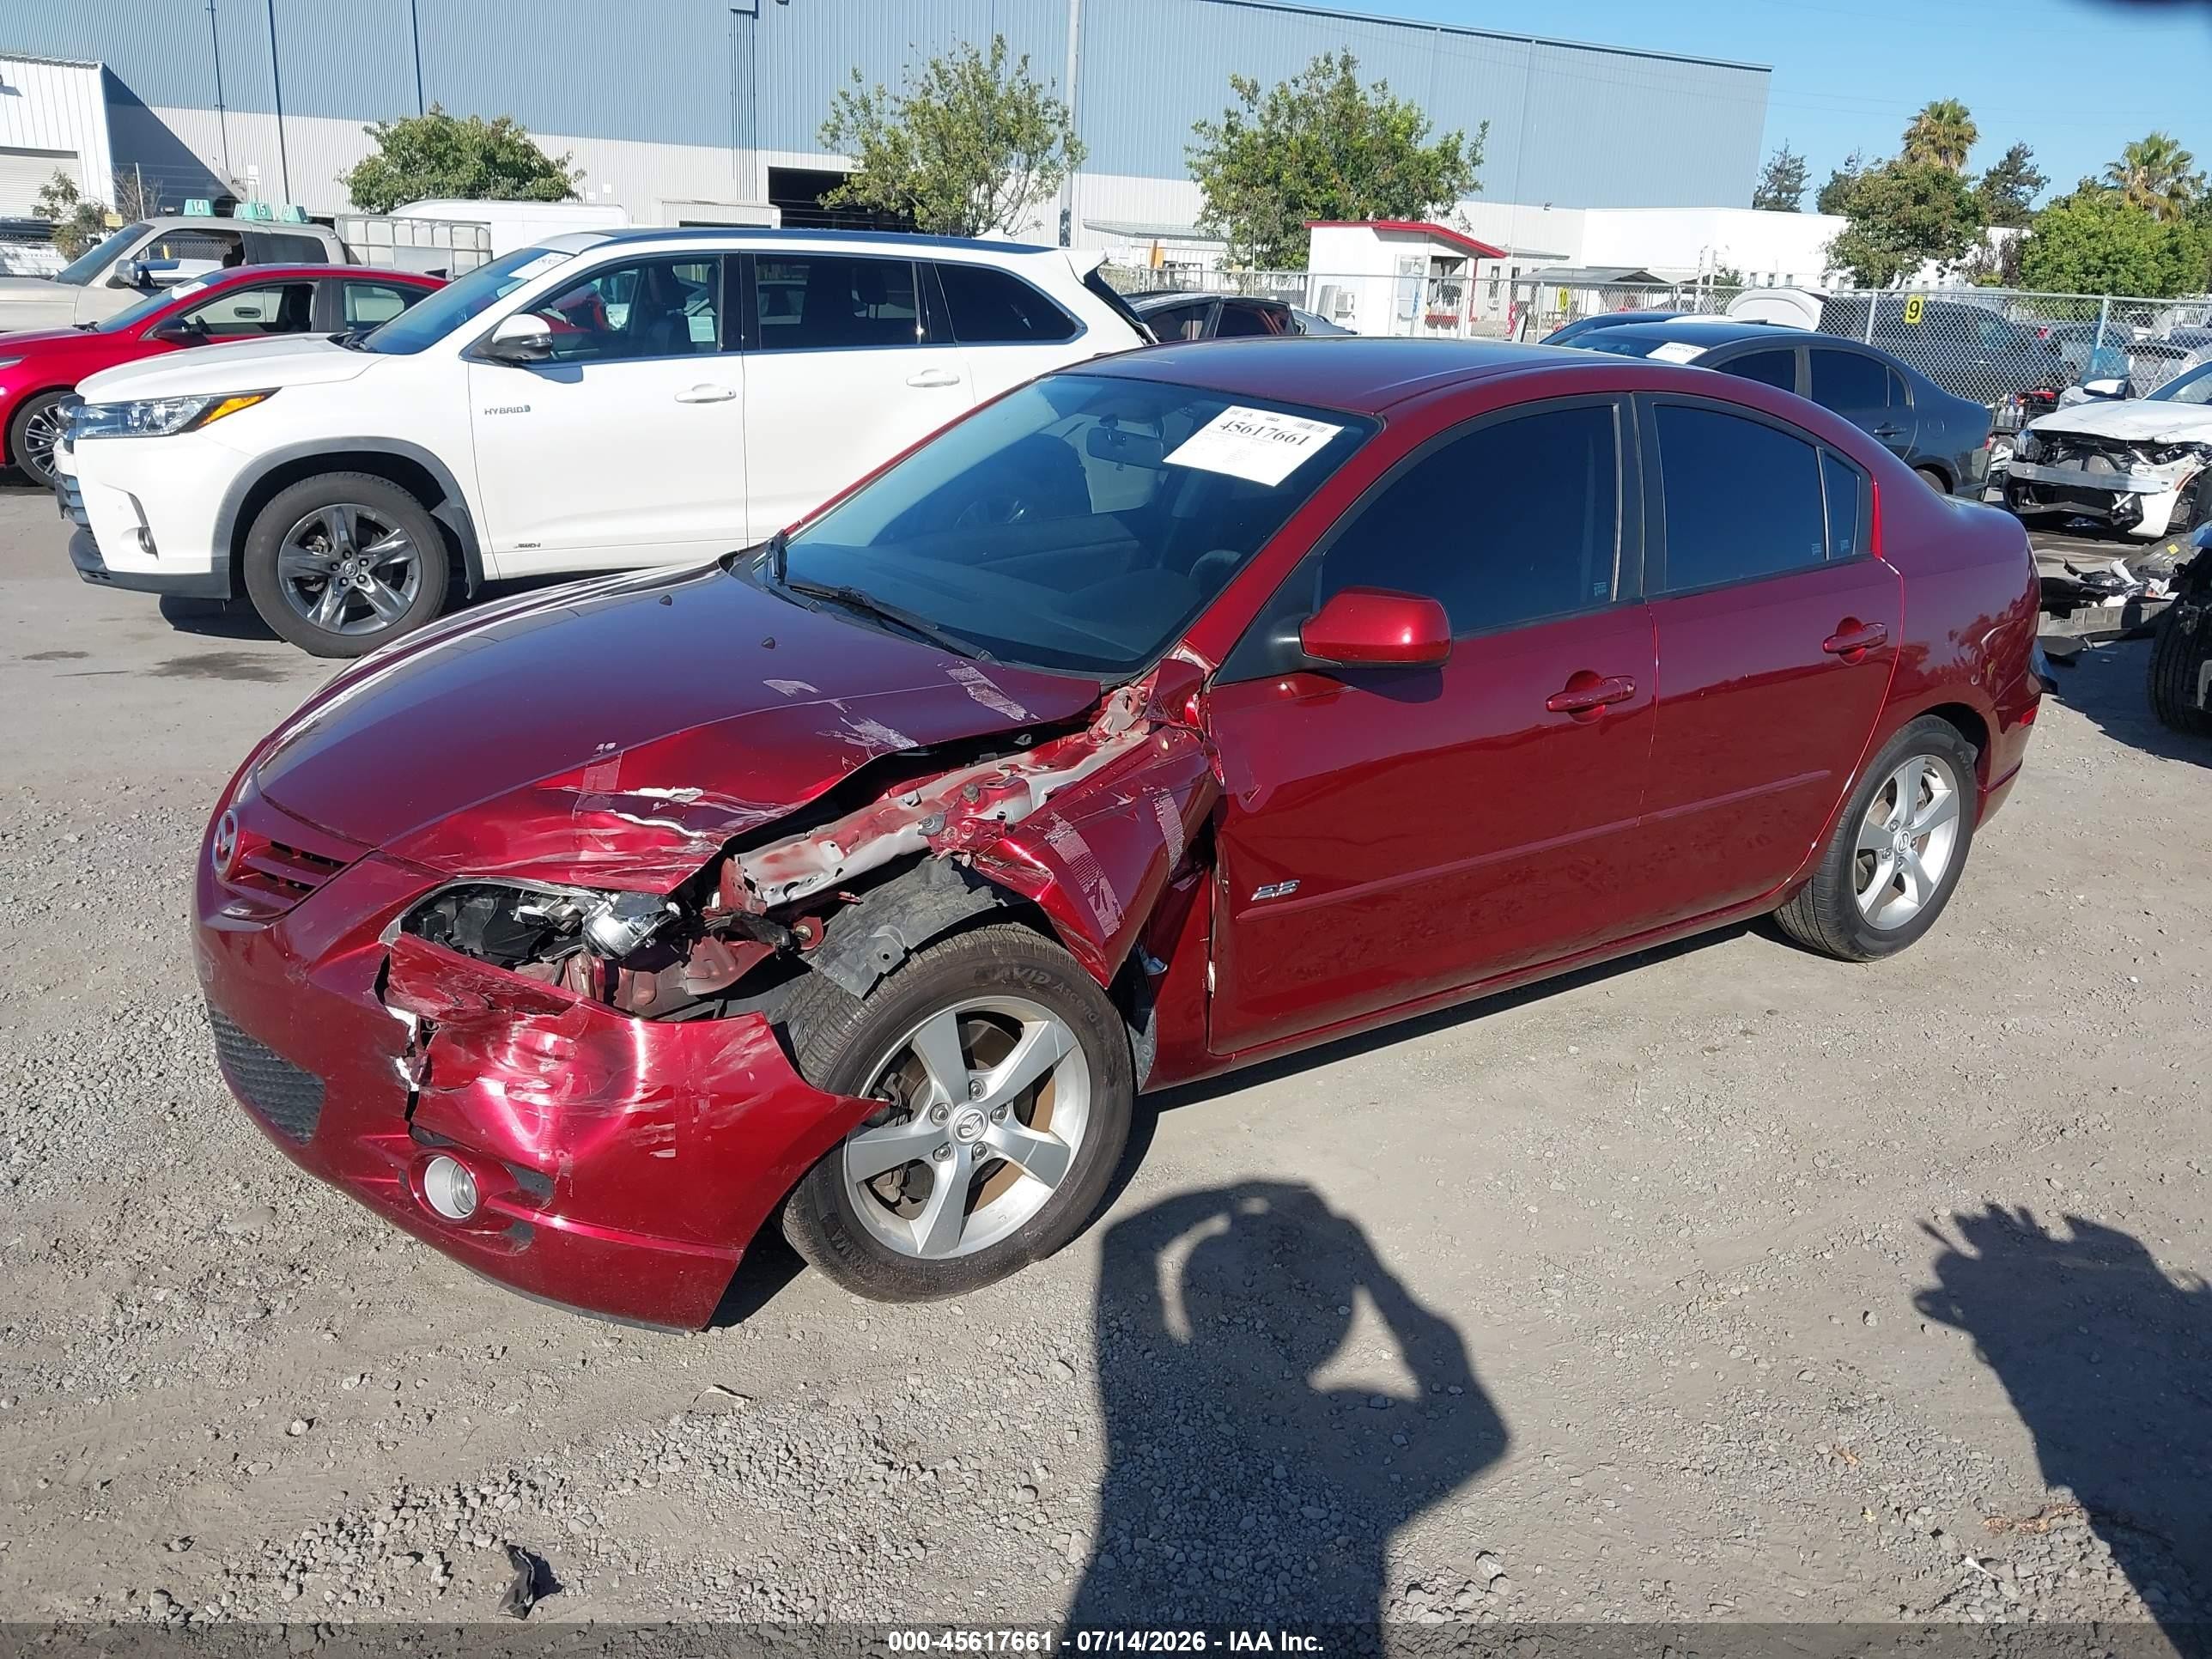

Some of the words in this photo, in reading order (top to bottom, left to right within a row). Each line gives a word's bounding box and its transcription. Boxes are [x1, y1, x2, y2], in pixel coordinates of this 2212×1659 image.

[192, 199, 204, 212] 14
[255, 203, 267, 215] 15
[1559, 291, 1567, 307] 10
[1908, 300, 1920, 319] 9
[484, 406, 523, 416] HYBRID
[1219, 419, 1311, 447] 45617661
